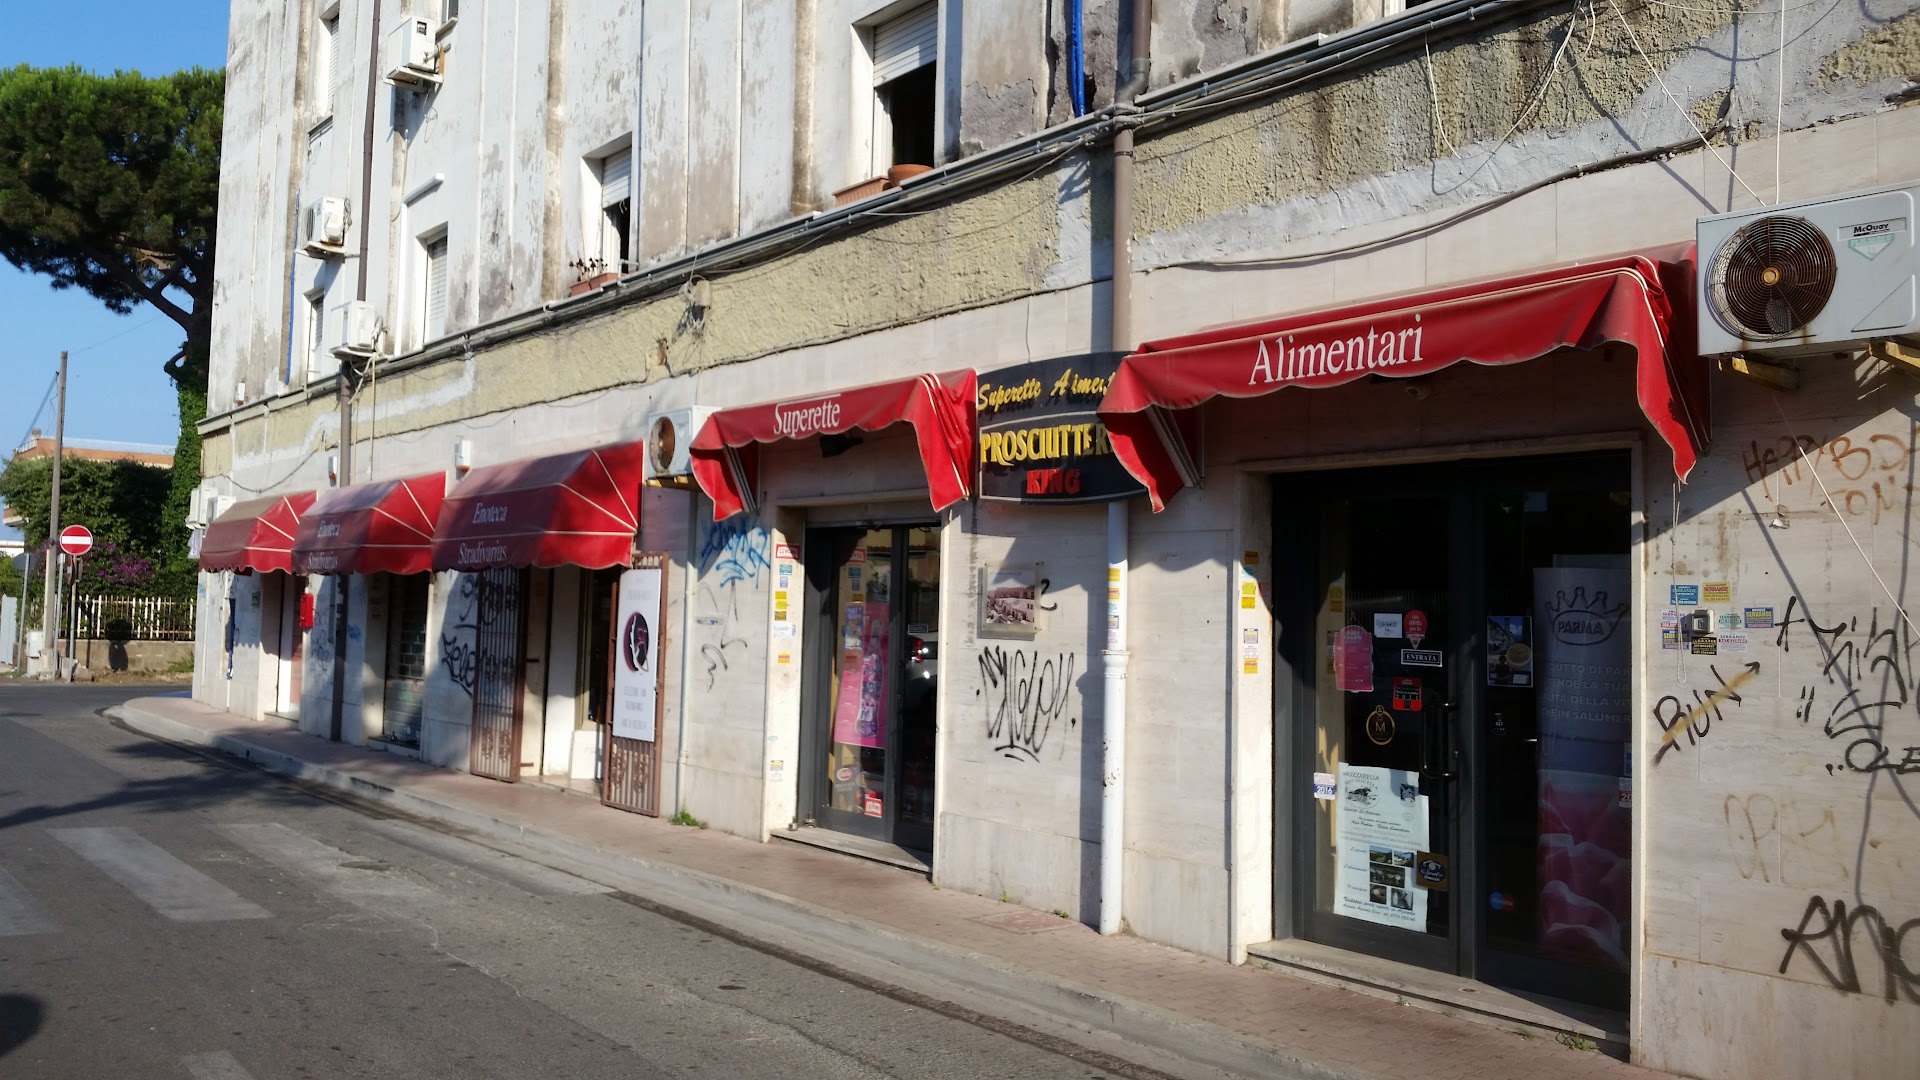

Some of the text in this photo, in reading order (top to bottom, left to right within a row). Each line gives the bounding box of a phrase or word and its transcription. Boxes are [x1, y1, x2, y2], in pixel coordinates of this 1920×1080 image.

[1853, 223, 1889, 233] McQuay
[1248, 313, 1423, 385] Alimentari
[977, 377, 1042, 413] Superette
[773, 399, 840, 439] Superette
[980, 423, 1113, 466] PROSCIUTTER
[1026, 469, 1081, 495] KING
[472, 503, 508, 524] Enoteca
[458, 540, 507, 565] Stradivarius
[1558, 620, 1604, 635] PARMA
[1406, 653, 1437, 662] ENTRATA
[1375, 722, 1386, 732] M
[1317, 786, 1333, 795] 2016
